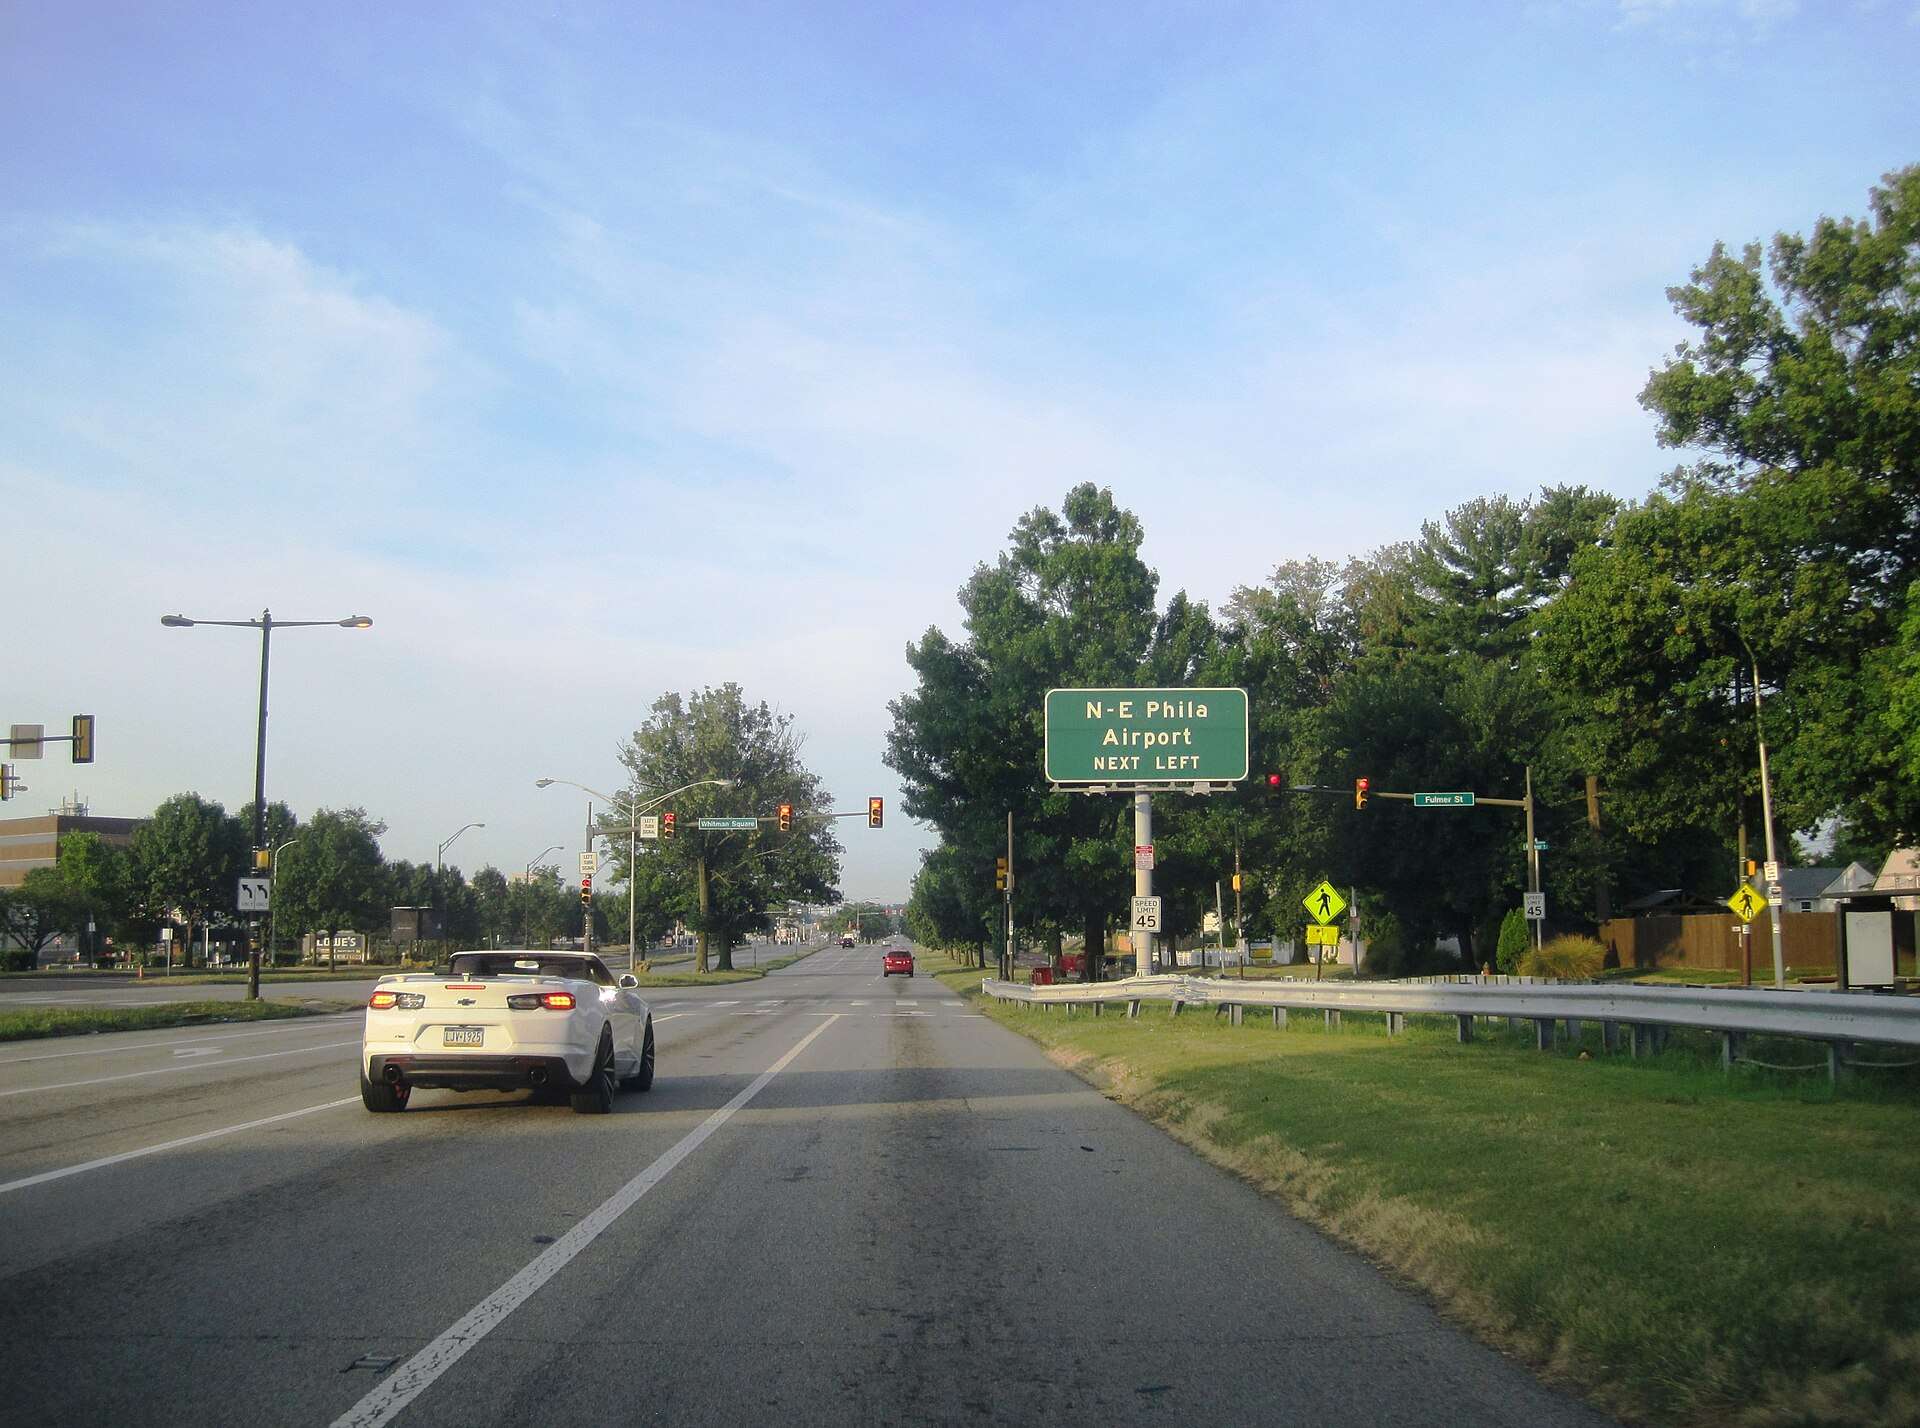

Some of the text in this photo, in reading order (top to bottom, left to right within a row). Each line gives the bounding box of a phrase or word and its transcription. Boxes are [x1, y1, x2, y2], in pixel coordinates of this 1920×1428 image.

[1086, 701, 1208, 719] N-E Phila
[1102, 728, 1192, 749] Airport
[1094, 756, 1200, 770] NEXT LEFT
[1425, 795, 1463, 804] Fulmer St
[731, 820, 755, 828] Square
[1527, 906, 1542, 916] 45
[1136, 915, 1156, 928] 45
